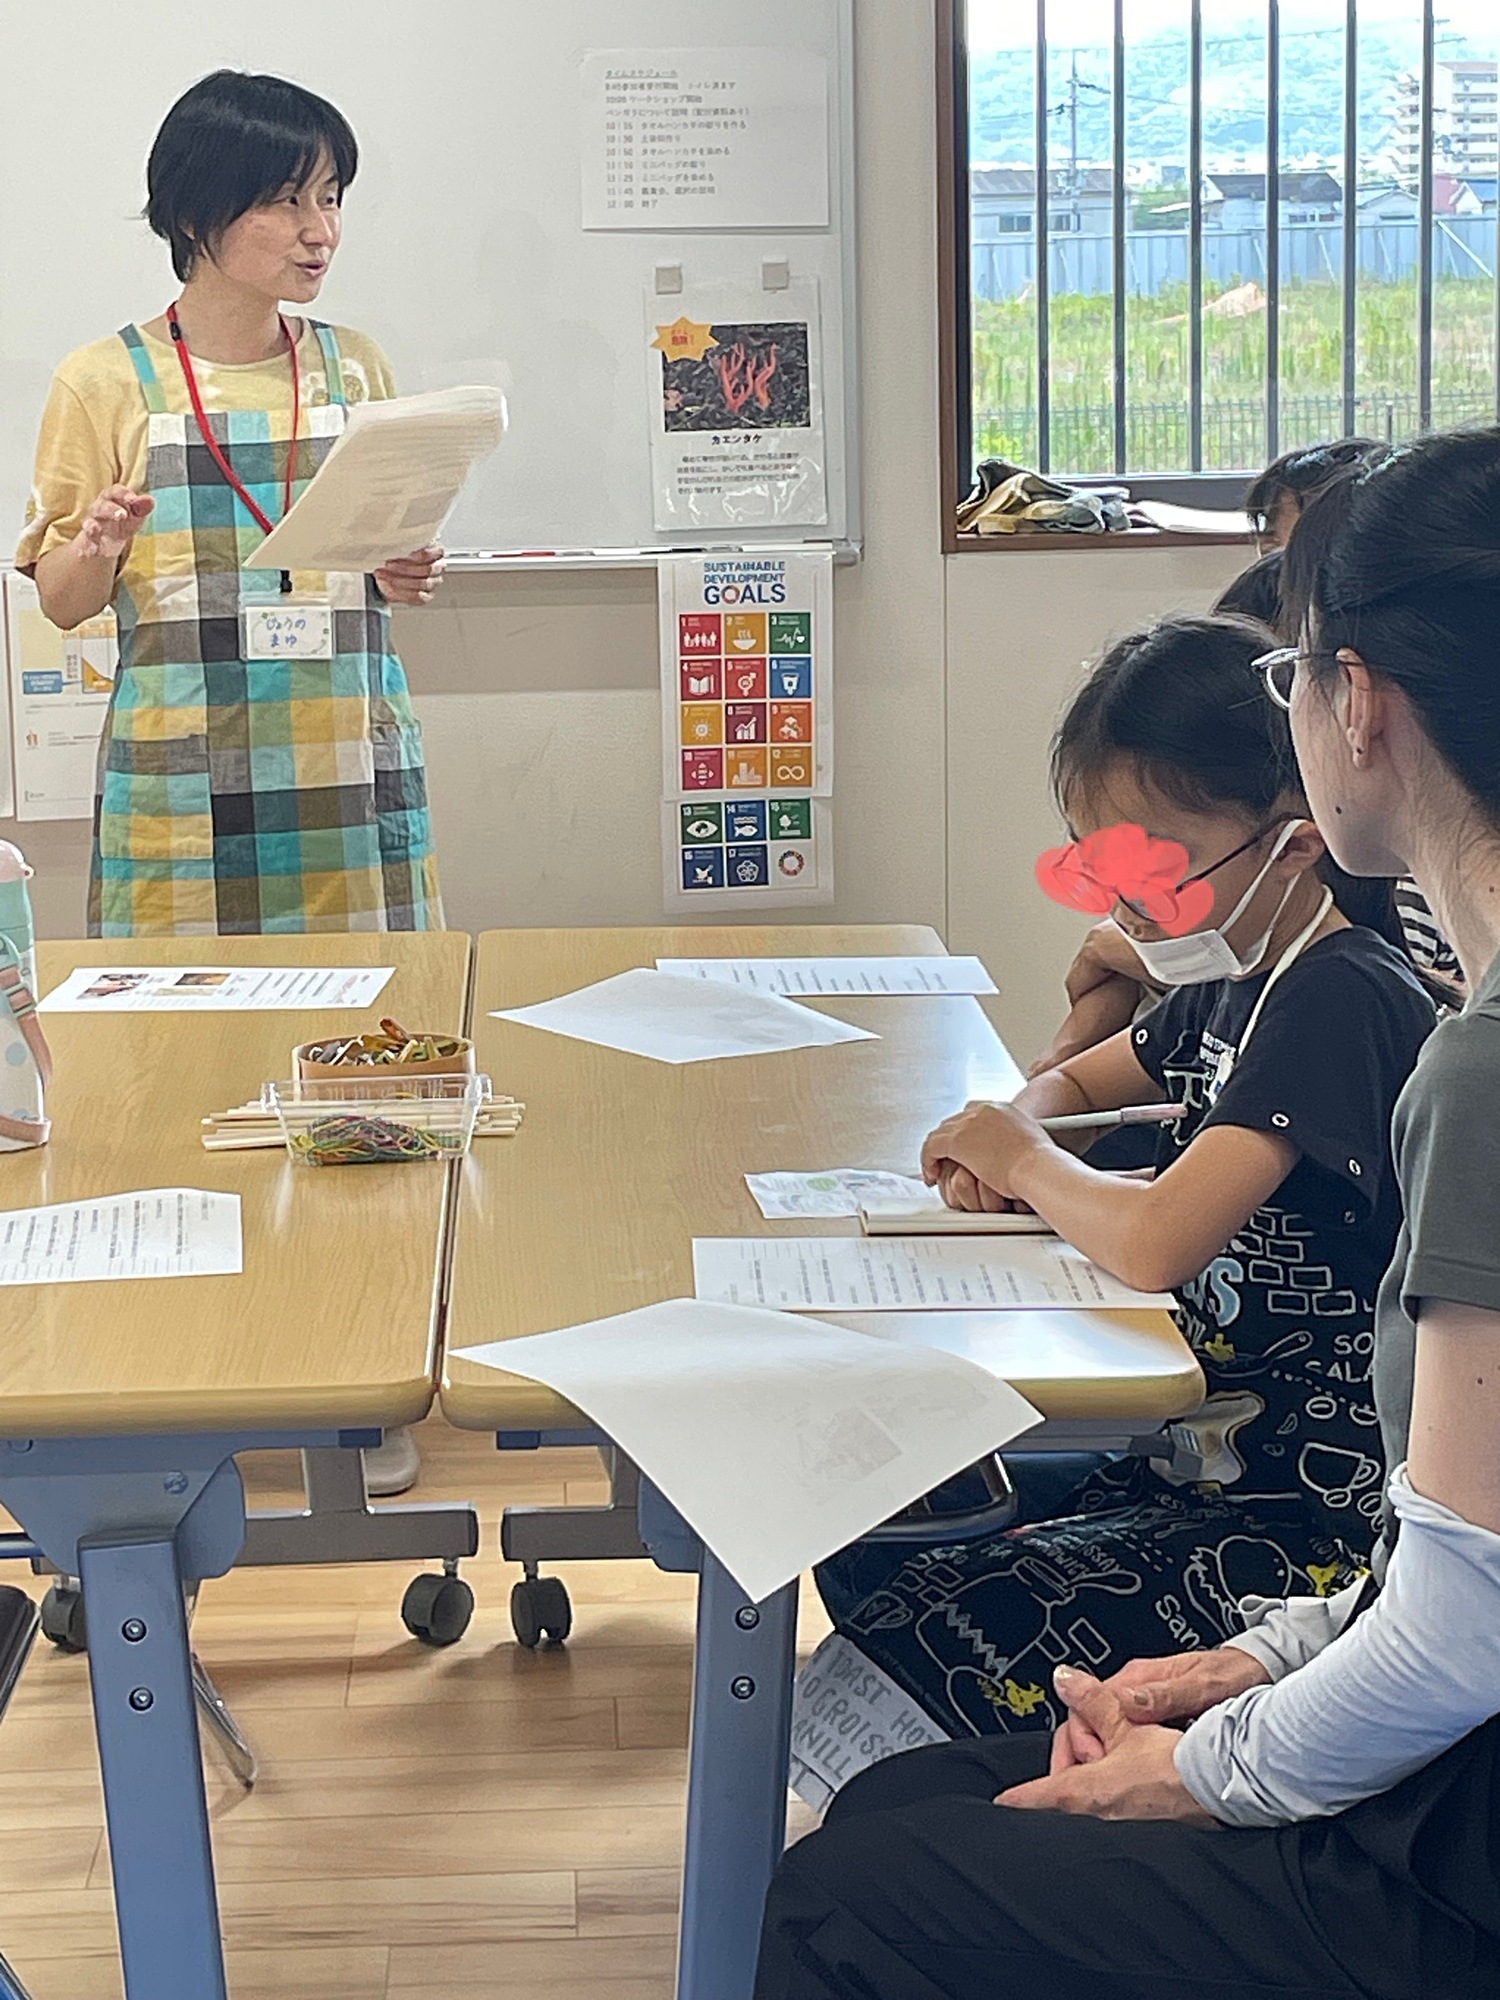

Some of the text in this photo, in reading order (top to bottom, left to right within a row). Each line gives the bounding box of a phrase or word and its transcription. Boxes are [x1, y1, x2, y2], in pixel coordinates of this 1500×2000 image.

[711, 433, 762, 446] カエンタケ
[704, 561, 786, 573] SUSTAINABLE
[704, 573, 786, 584] DEVELOPMENT
[704, 583, 786, 605] GOALS
[270, 633, 297, 648] まゆ
[1155, 1594, 1212, 1651] San
[827, 1650, 892, 1706] TOAST
